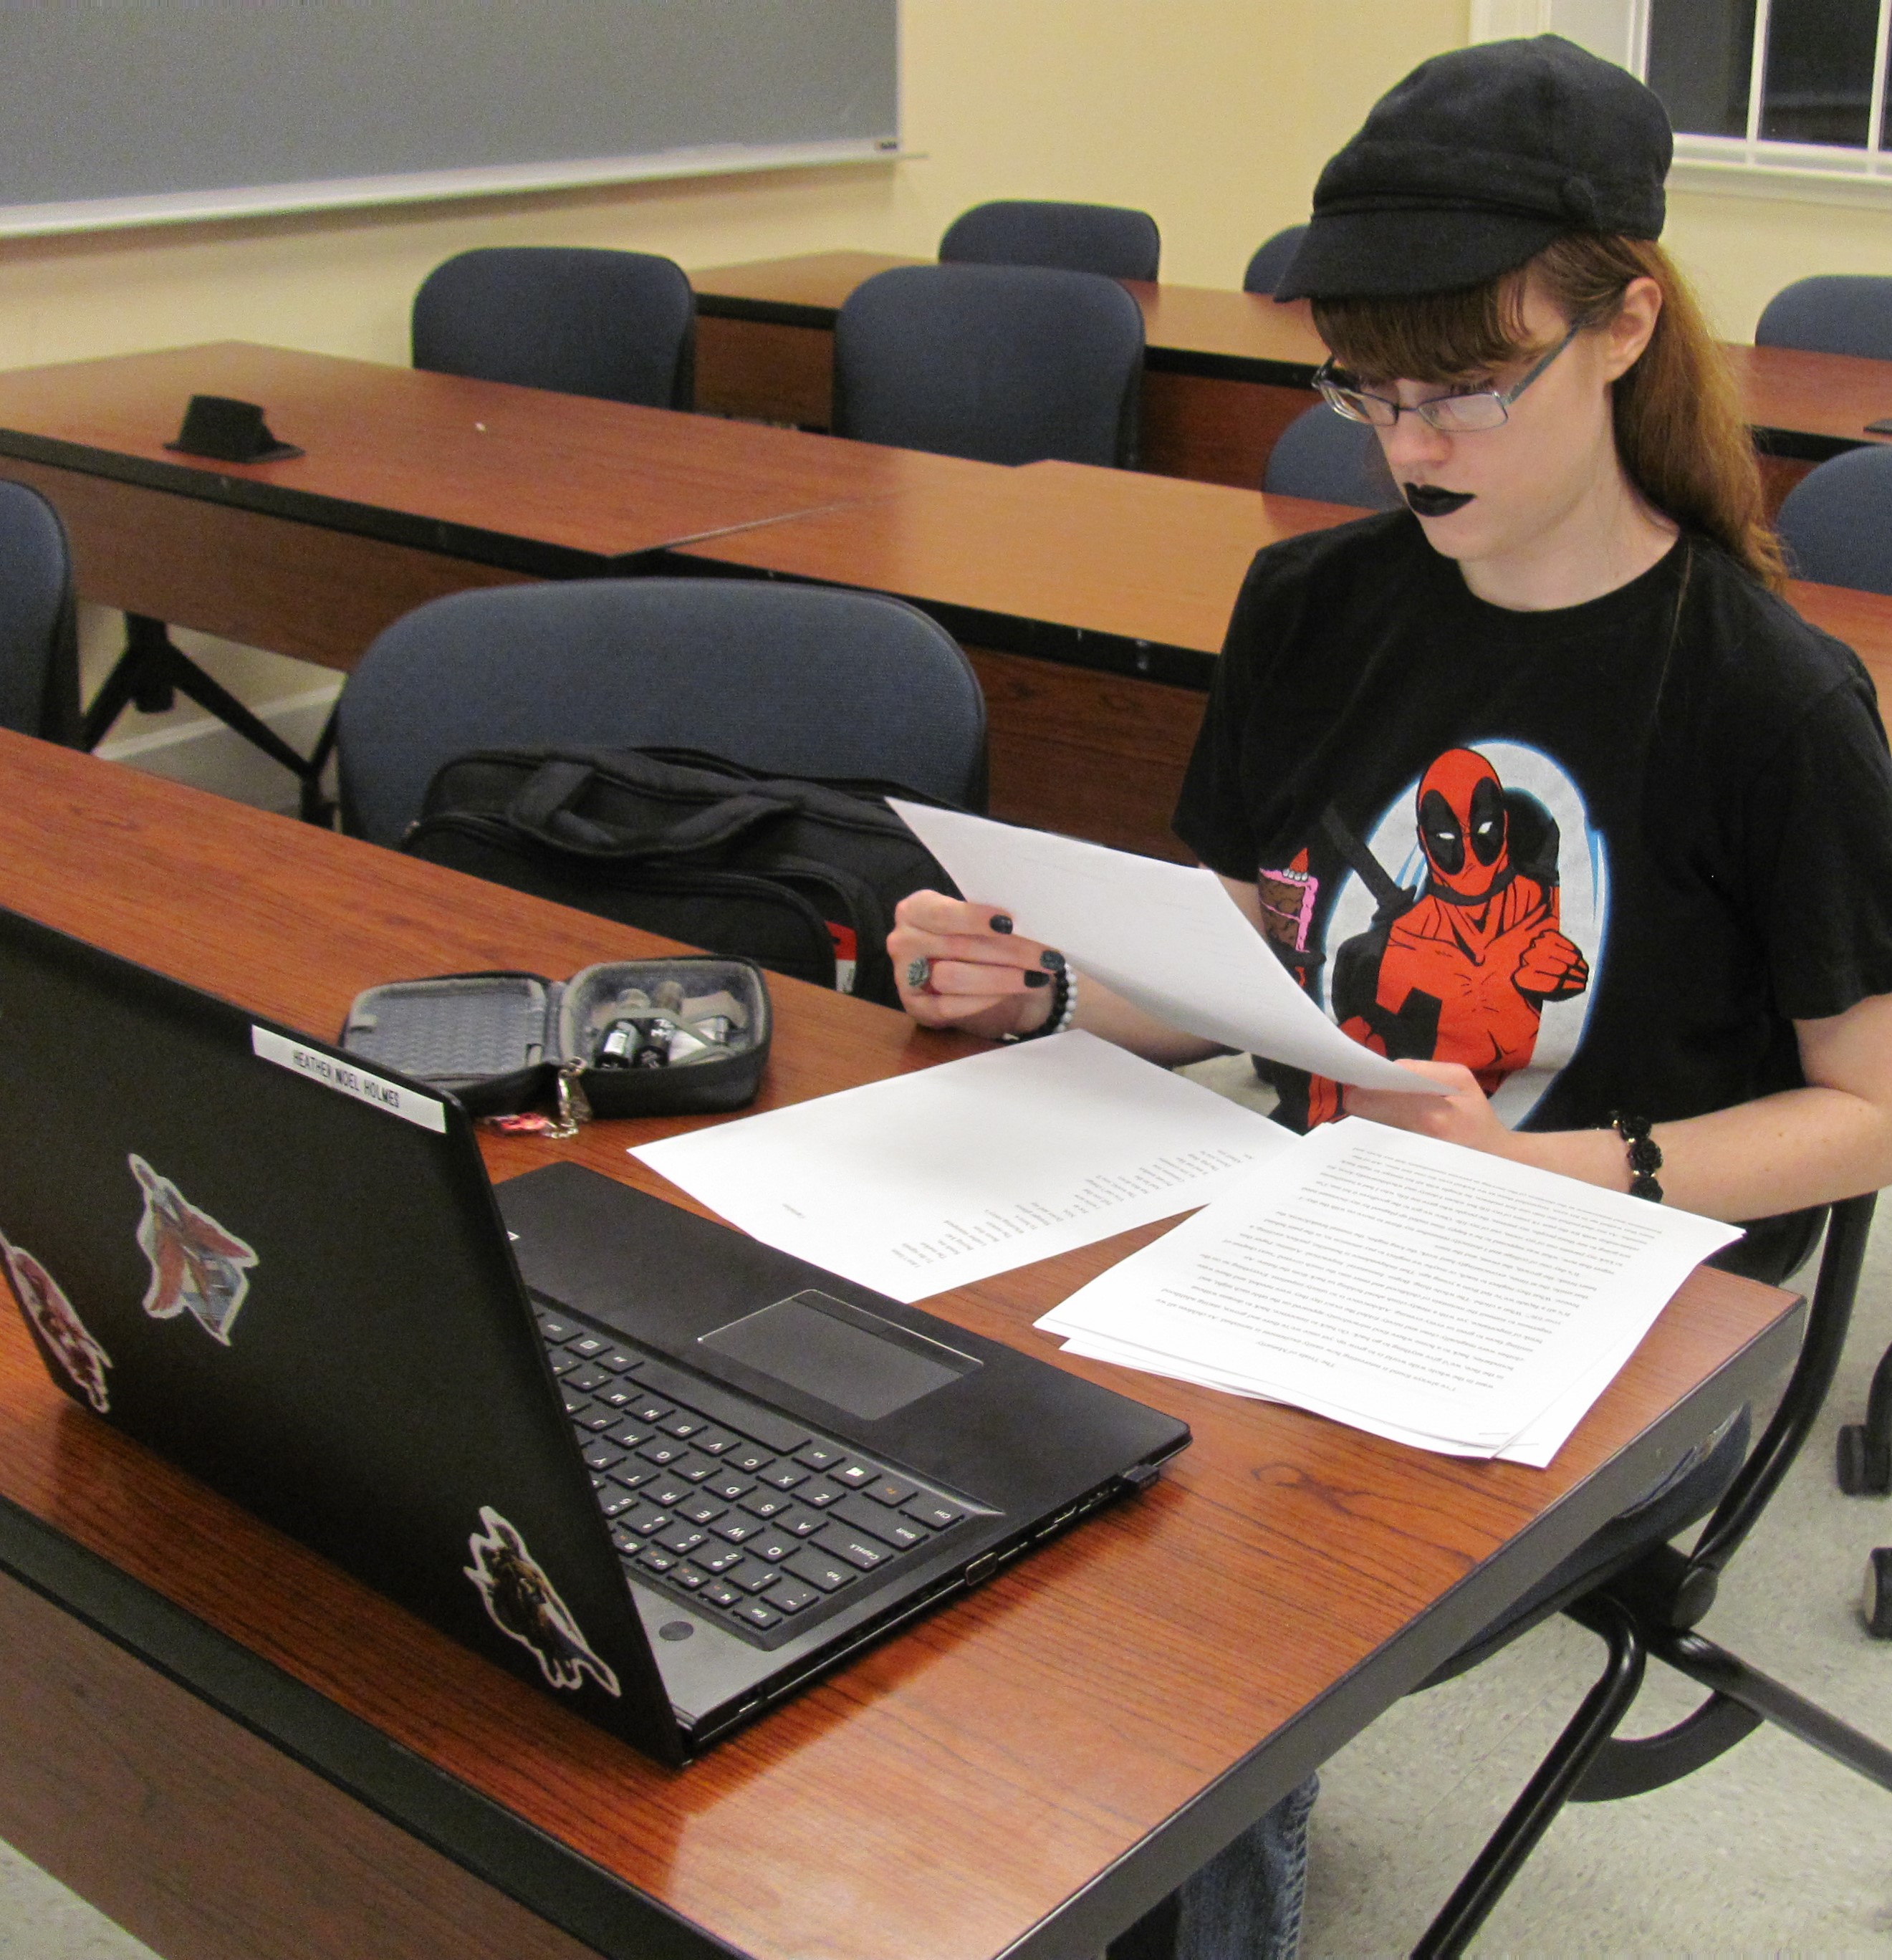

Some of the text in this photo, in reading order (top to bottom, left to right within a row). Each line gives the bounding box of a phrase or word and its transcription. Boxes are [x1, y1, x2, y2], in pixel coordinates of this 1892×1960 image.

[335, 1068, 360, 1092] NOEL
[364, 1079, 400, 1108] HOLMES
[644, 1409, 658, 1418] N
[623, 1434, 639, 1443] H
[778, 1476, 794, 1484] X
[661, 1492, 676, 1501] R
[814, 1493, 830, 1502] Z
[761, 1504, 774, 1512] S
[696, 1510, 711, 1519] E
[727, 1527, 745, 1537] W
